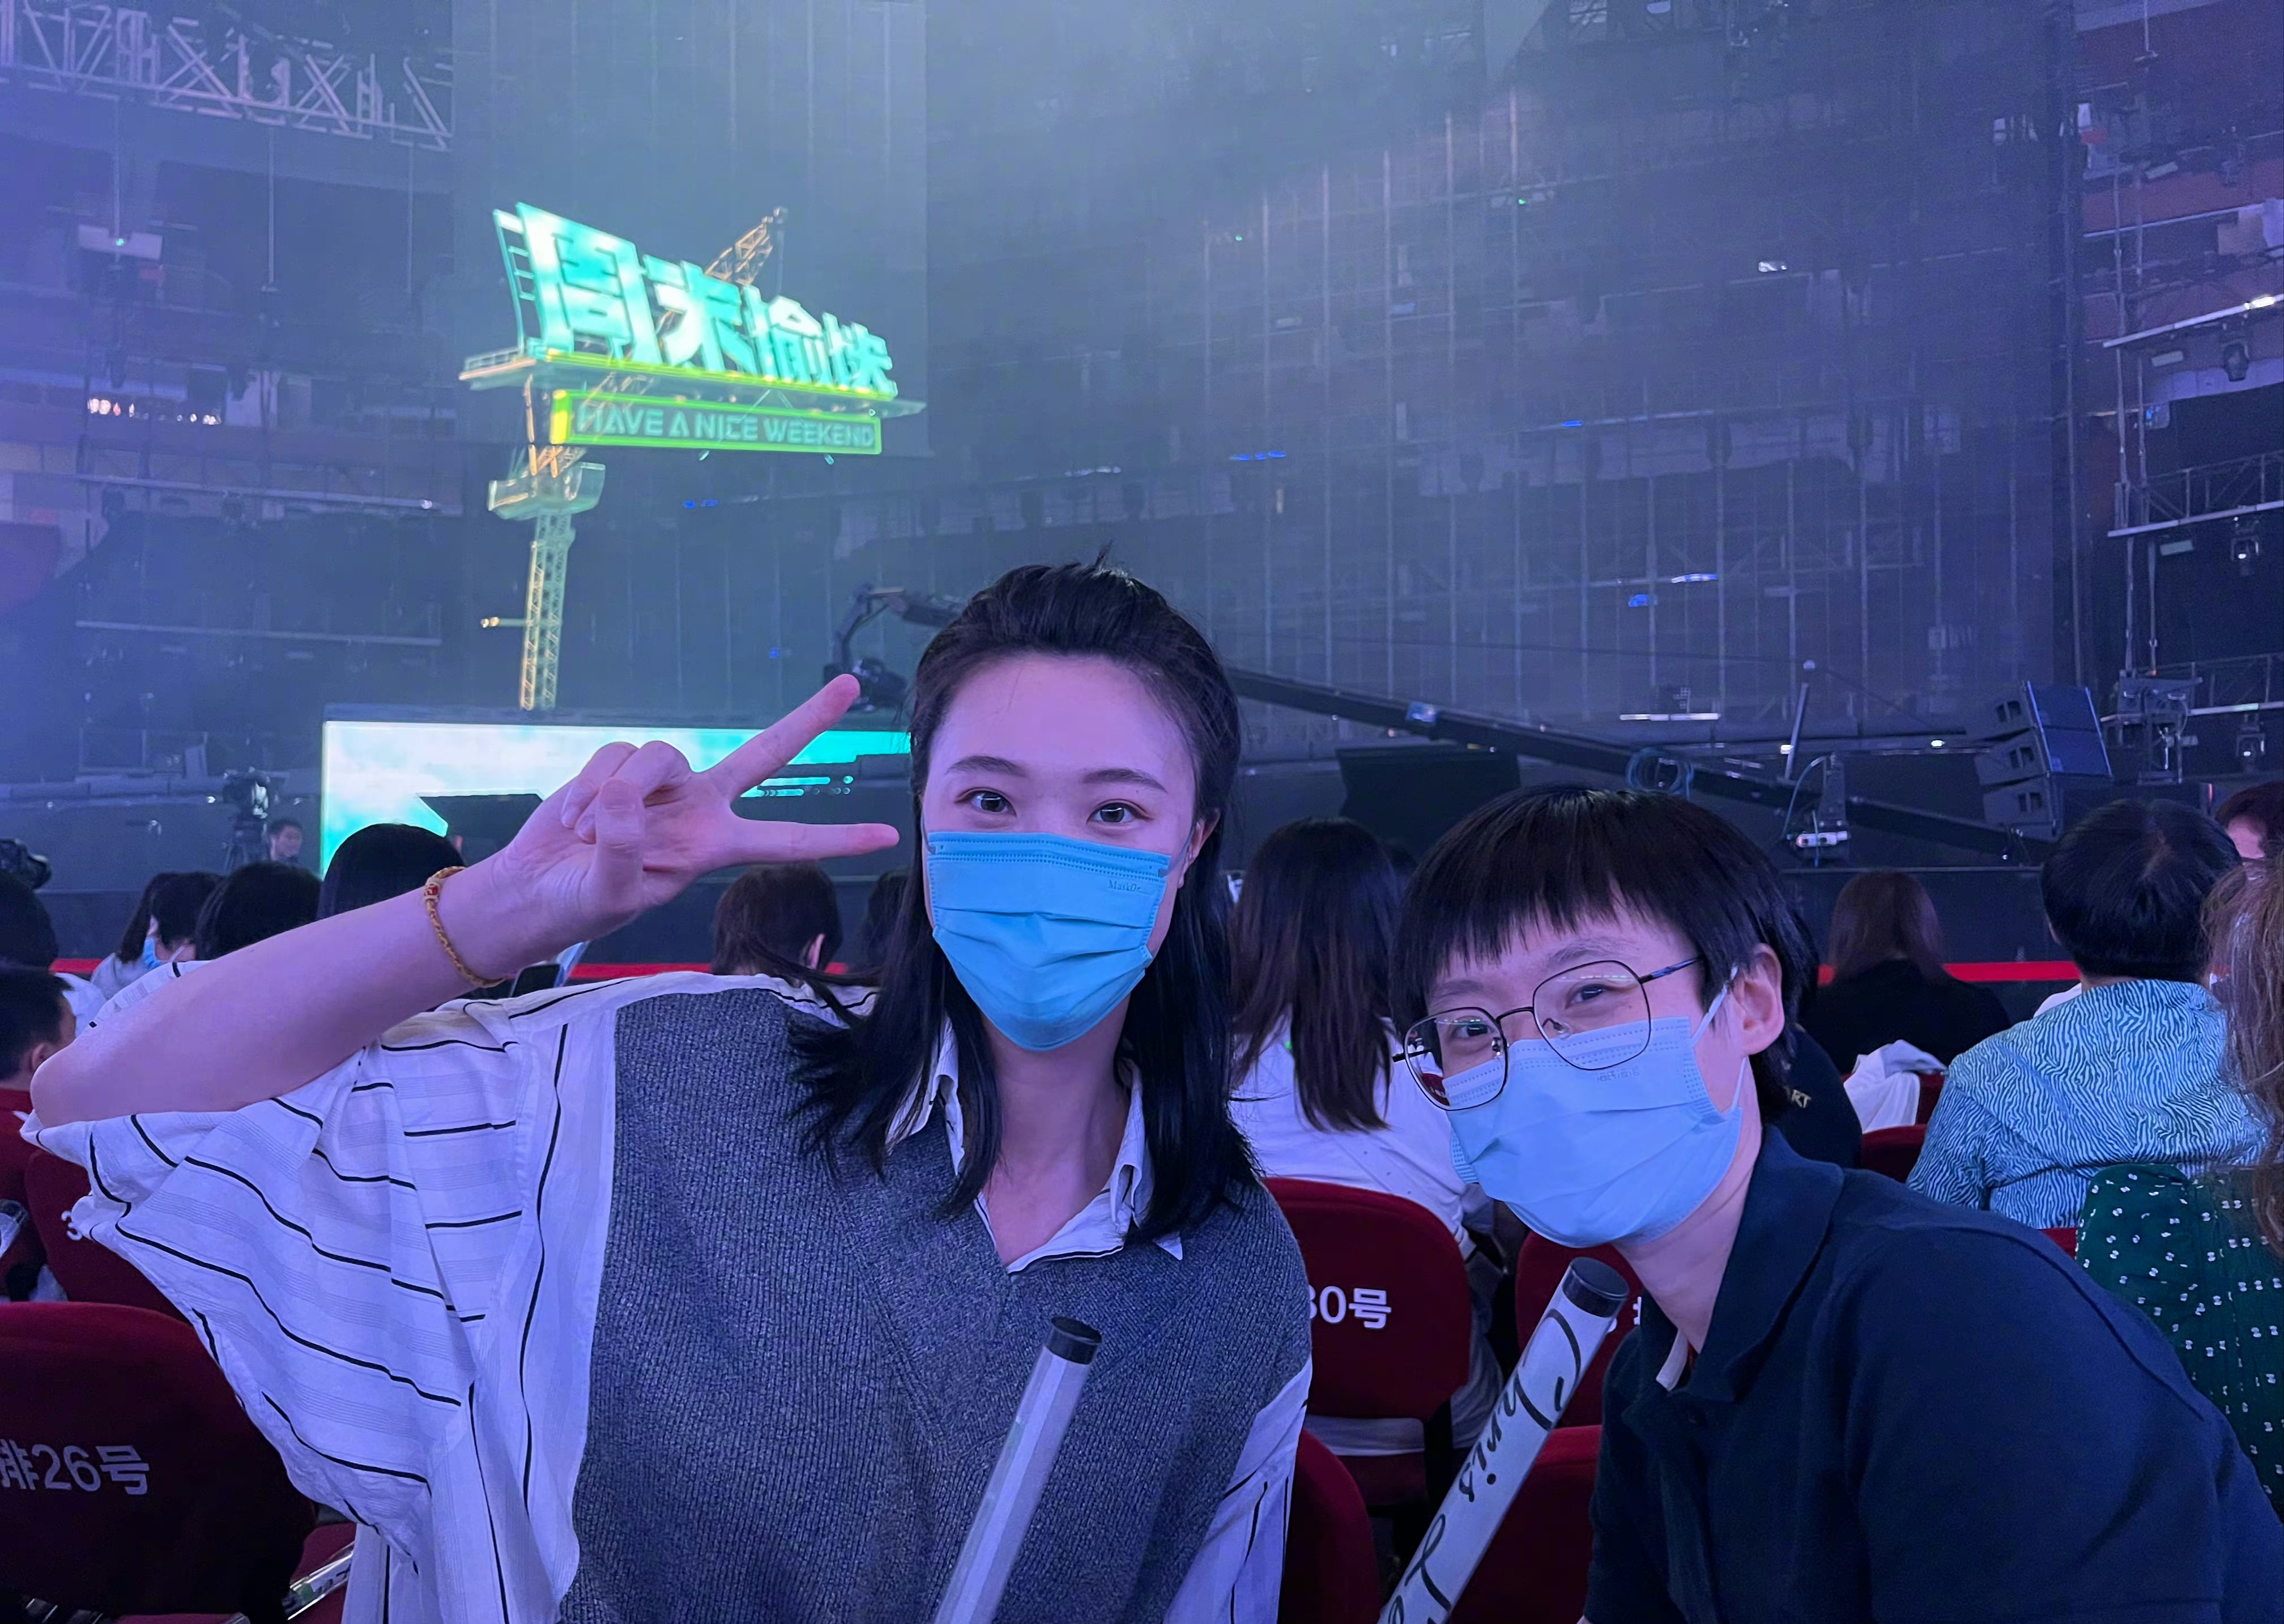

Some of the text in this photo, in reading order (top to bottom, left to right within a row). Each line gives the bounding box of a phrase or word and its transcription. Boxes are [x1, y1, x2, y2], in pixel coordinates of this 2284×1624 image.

[513, 201, 898, 400] 周末愉快
[576, 403, 874, 448] HAVE A NICE WEEKEND
[1459, 1308, 1581, 1503] Chris
